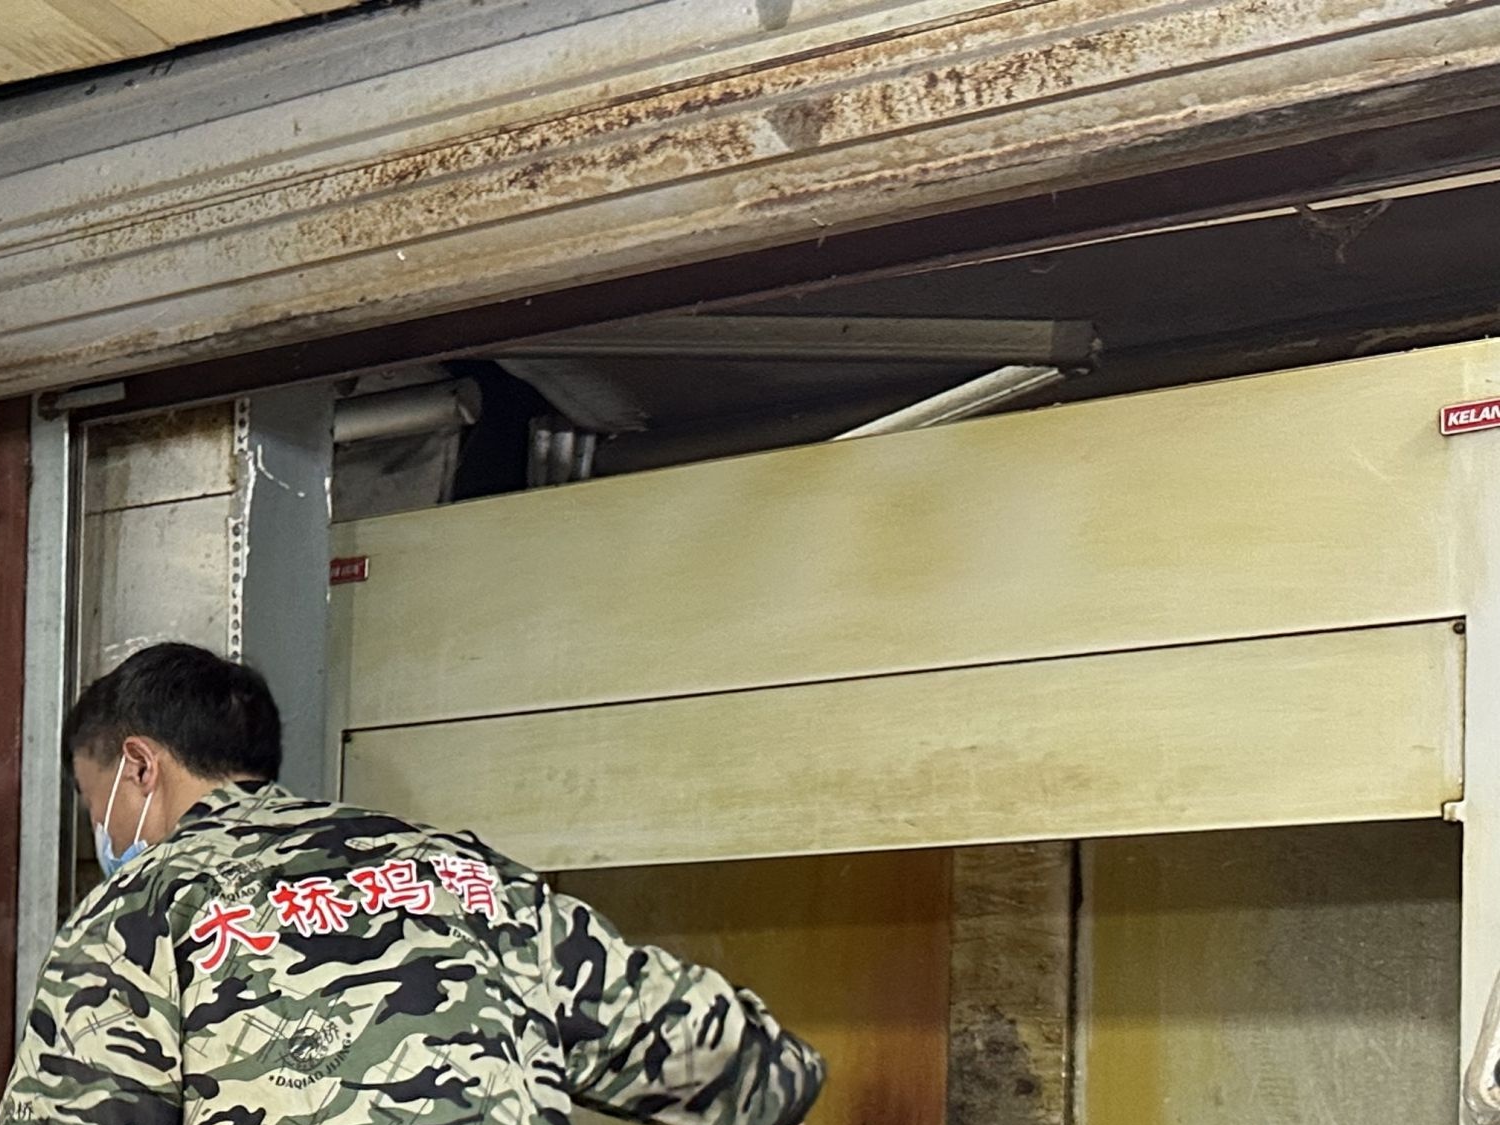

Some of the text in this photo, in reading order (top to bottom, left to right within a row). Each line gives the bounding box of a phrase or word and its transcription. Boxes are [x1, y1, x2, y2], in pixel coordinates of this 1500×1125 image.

[190, 856, 499, 974] 大桥鸡精
[275, 1070, 324, 1091] DAQIAO
